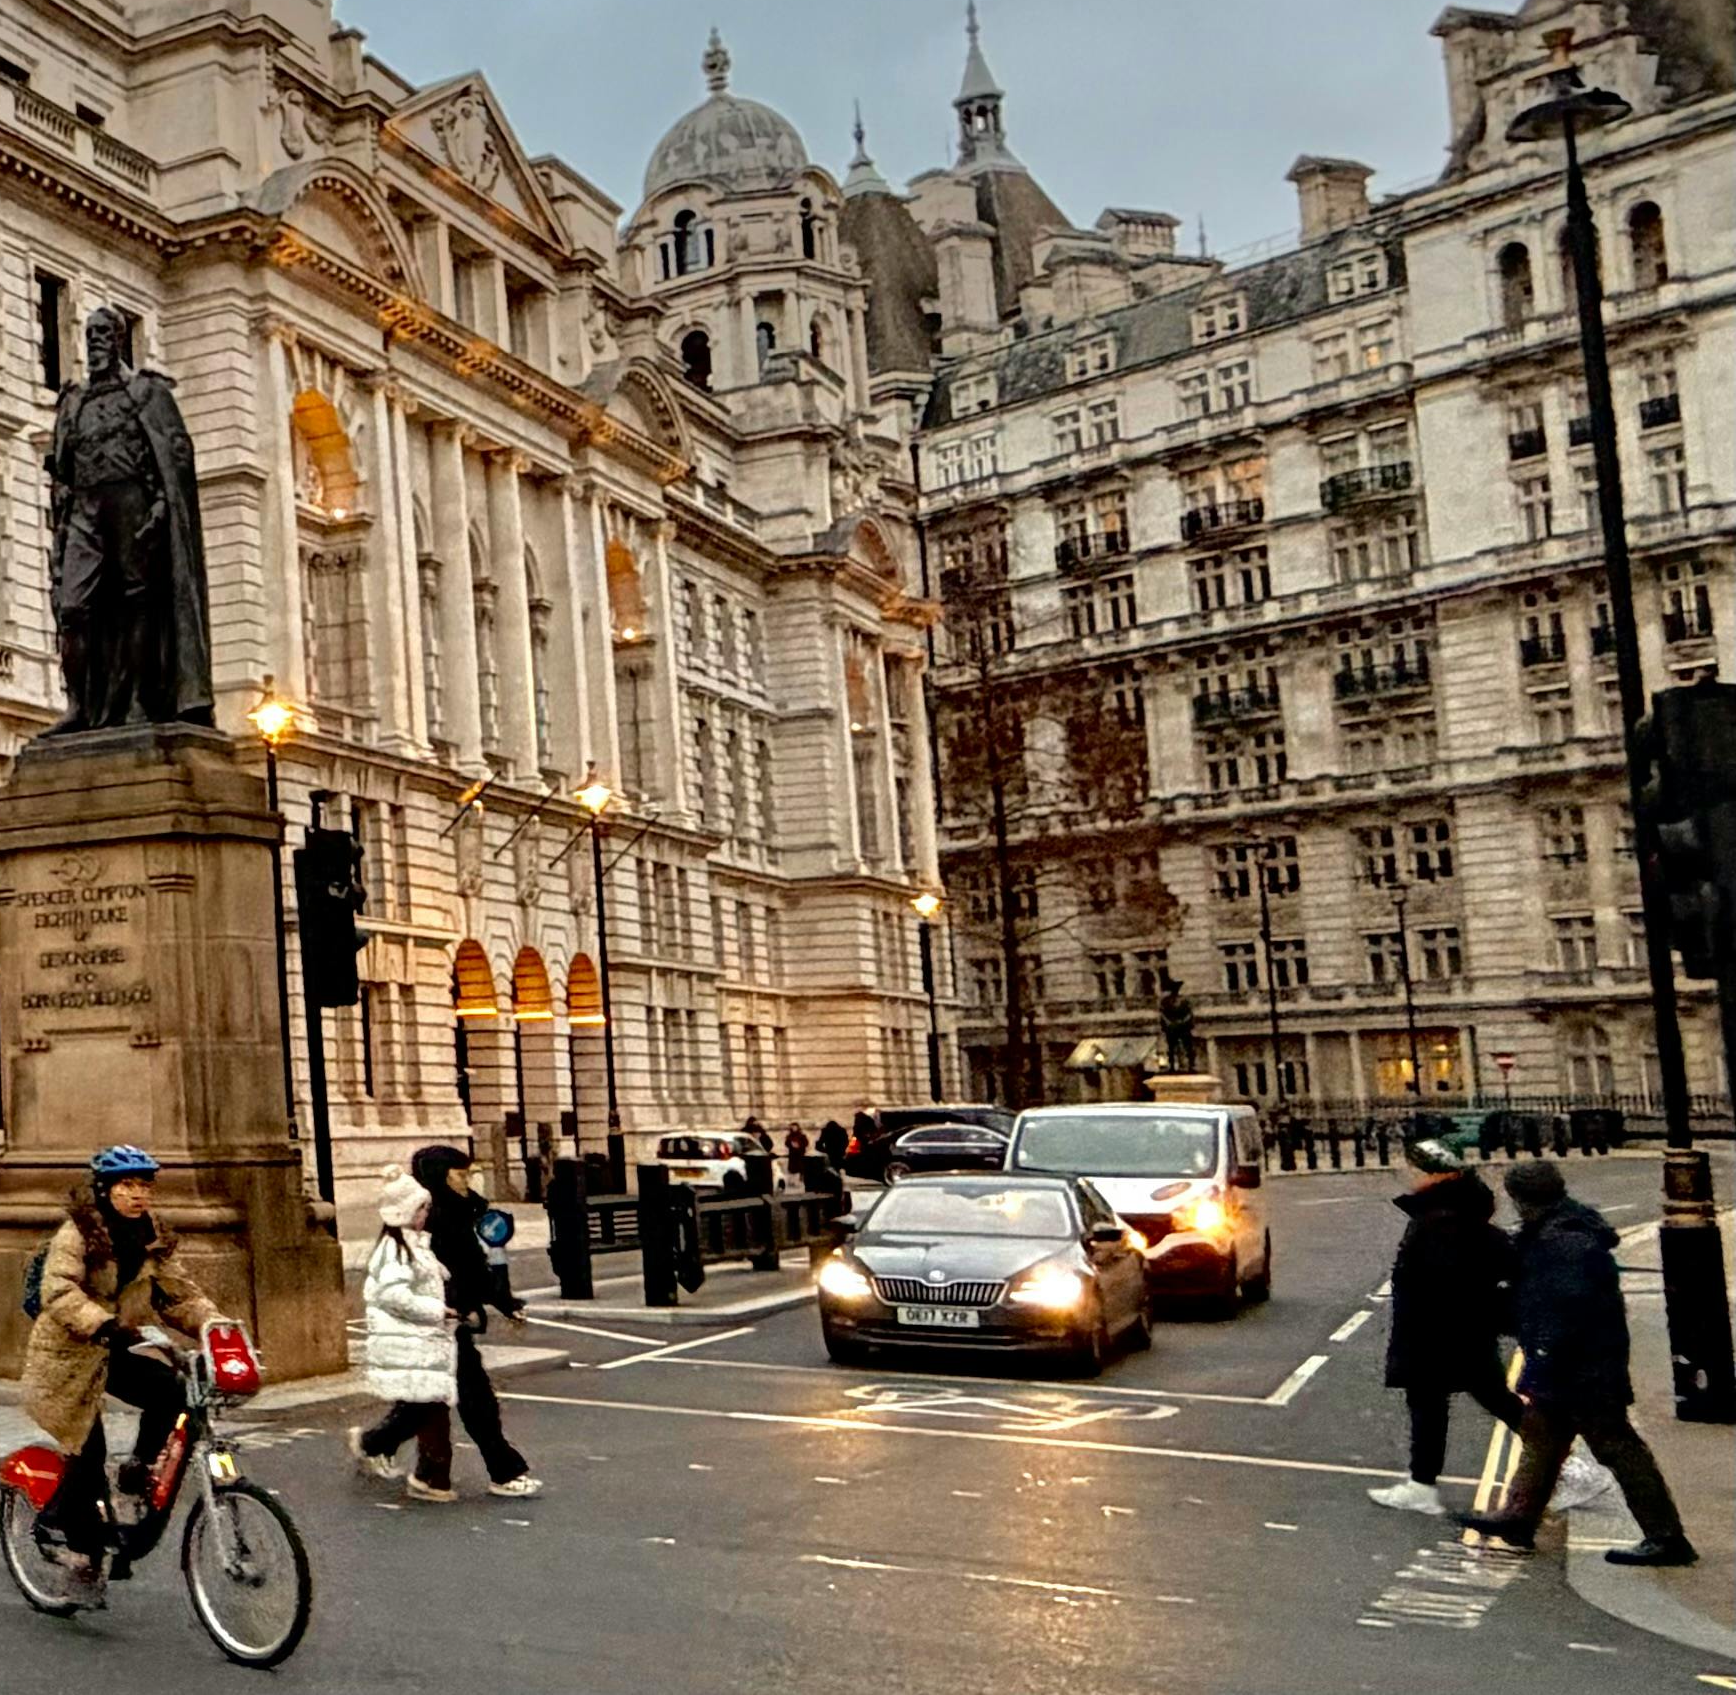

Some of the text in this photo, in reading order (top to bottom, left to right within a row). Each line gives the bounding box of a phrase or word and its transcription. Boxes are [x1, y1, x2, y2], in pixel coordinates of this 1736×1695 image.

[17, 884, 145, 907] SPENCER COMPTON
[35, 907, 128, 929] EIGHTH DUKE
[39, 947, 126, 969] DEVONSHIRE
